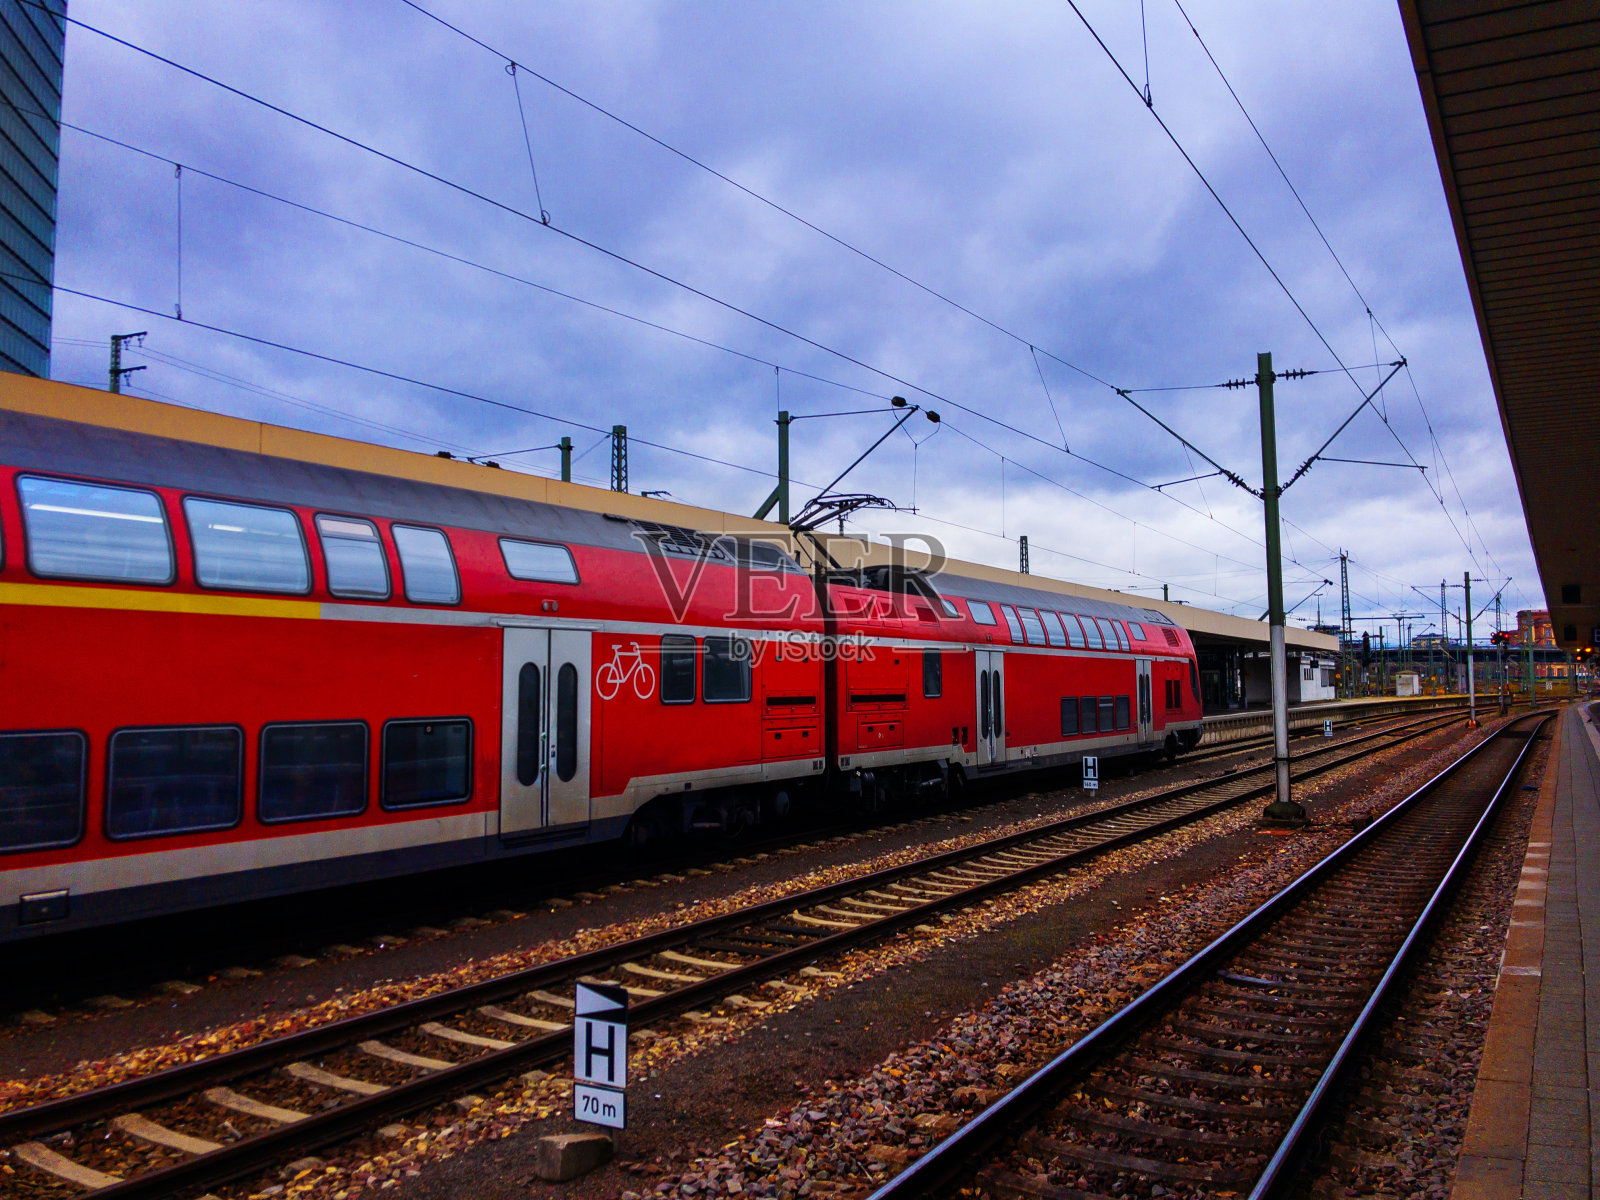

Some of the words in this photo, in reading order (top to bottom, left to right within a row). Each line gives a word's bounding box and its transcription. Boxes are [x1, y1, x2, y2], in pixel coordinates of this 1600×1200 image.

[1324, 720, 1332, 731] H
[1084, 757, 1097, 777] H
[585, 1021, 615, 1082] H
[582, 1095, 599, 1115] 70
[603, 1103, 616, 1118] m
